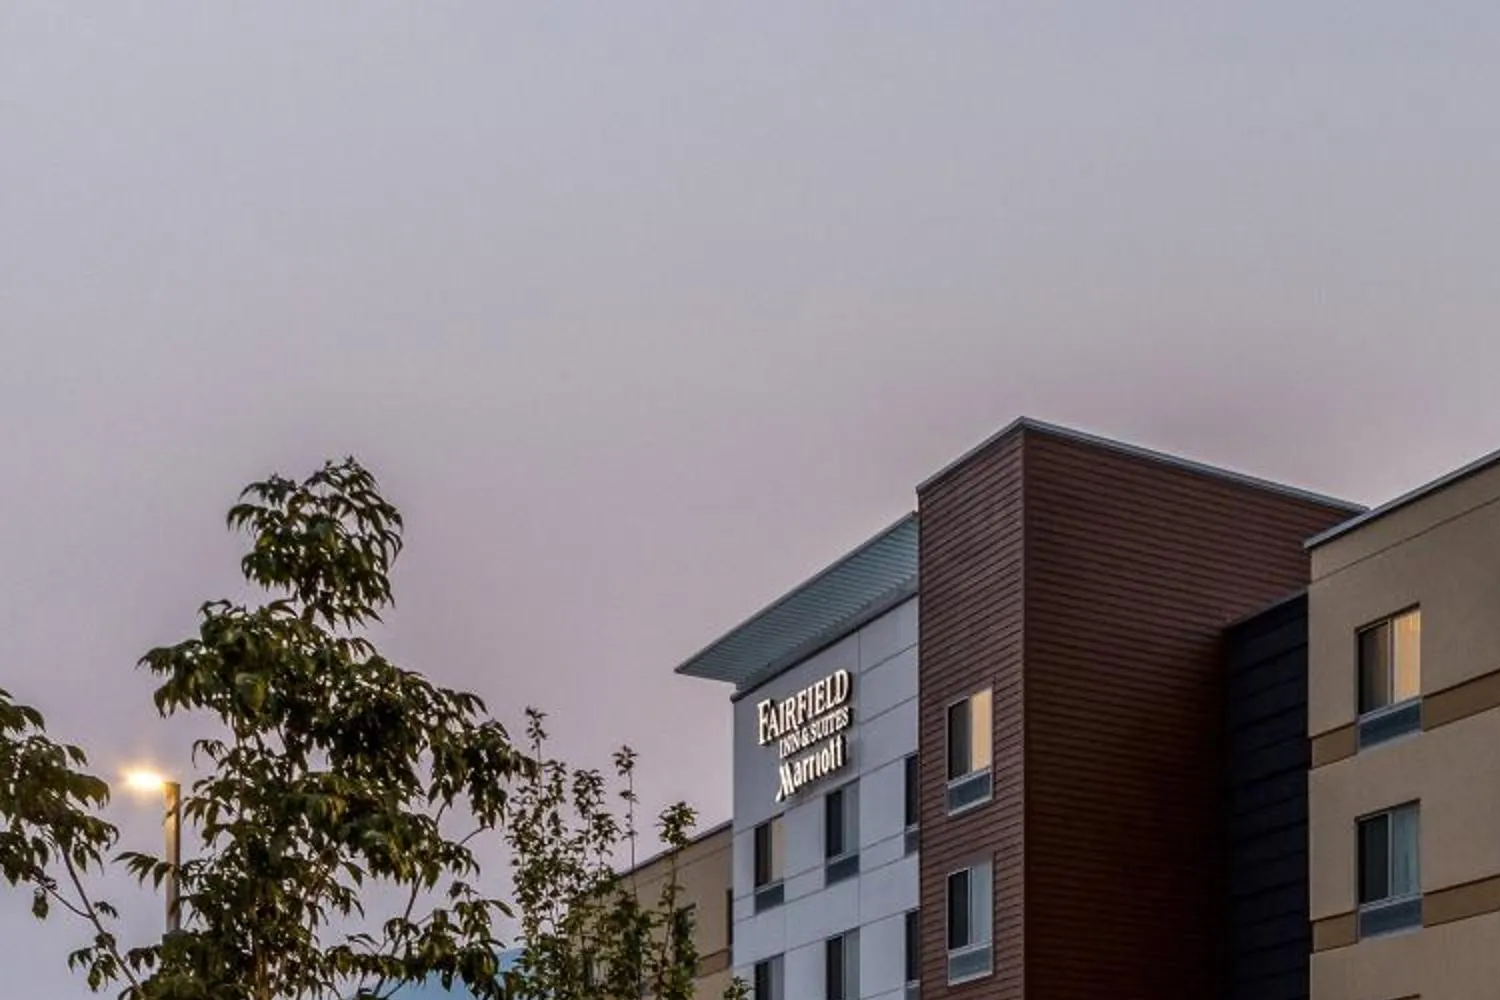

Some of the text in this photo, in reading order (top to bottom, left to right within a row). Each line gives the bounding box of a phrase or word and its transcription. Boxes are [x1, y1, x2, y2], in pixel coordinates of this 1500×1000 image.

[757, 668, 849, 745] FAIRFIELD
[779, 733, 801, 758] INN
[811, 705, 849, 743] SUITES
[775, 734, 843, 802] Marriott
